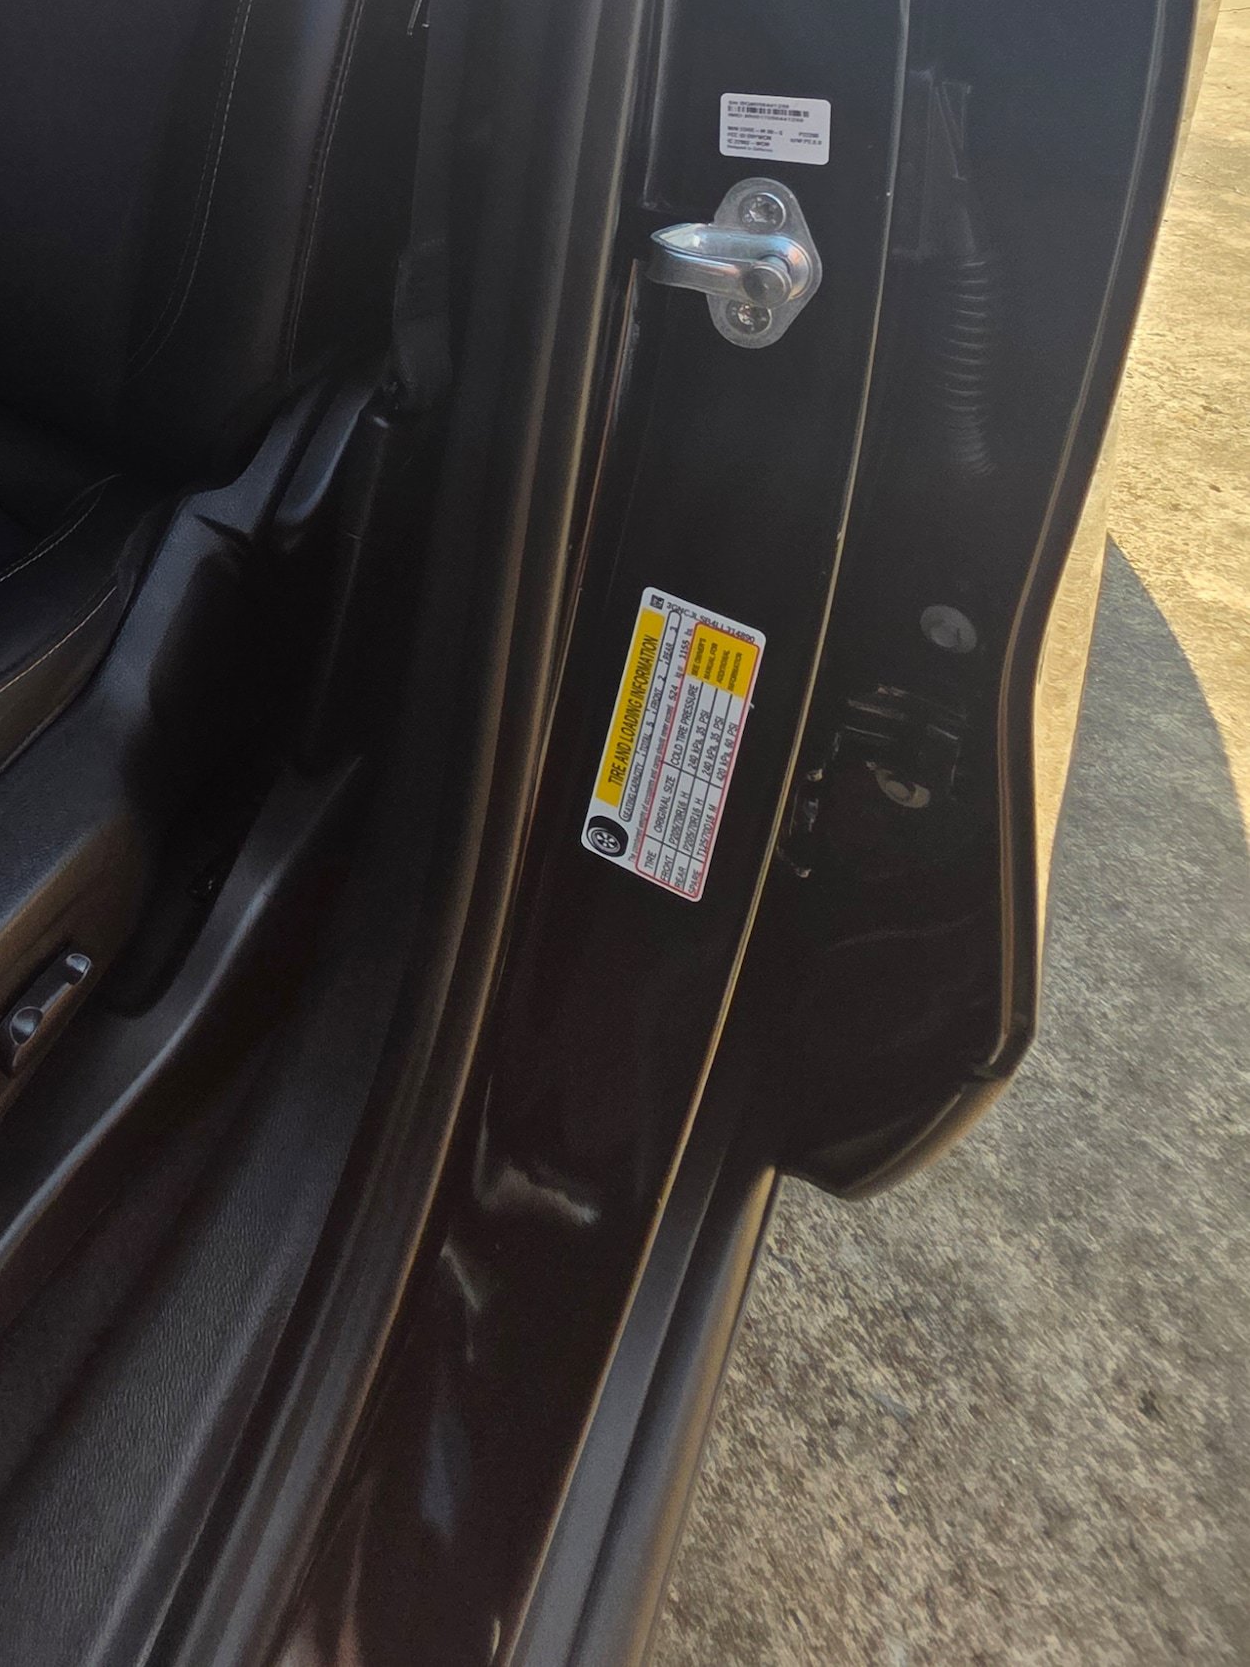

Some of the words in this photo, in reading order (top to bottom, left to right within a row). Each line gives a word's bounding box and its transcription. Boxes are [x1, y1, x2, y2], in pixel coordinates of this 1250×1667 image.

[694, 637, 706, 664] OWNER'S
[703, 655, 715, 680] MANUAL
[709, 642, 718, 655] FOR
[629, 633, 658, 700] INFORMATION
[667, 683, 678, 701] 524
[678, 638, 689, 659] 1155
[691, 664, 699, 676] SEE
[715, 649, 730, 684] ADDITIONAL
[726, 651, 742, 691] INFORMATION
[680, 683, 698, 725] PRESSURE
[618, 697, 642, 743] LOADING
[698, 709, 709, 724] PSI
[713, 715, 724, 730] PSI
[727, 721, 738, 736] PSI
[622, 791, 636, 820] SEATING
[629, 761, 643, 793] CAPACITY
[639, 732, 651, 753] TOTAL
[649, 686, 662, 710] FRONT
[662, 641, 673, 661] REAR
[675, 724, 688, 743] TIRE
[695, 725, 705, 736] 35
[709, 731, 720, 742] 35
[613, 741, 631, 765] AND
[670, 743, 683, 766] COLD
[724, 737, 734, 749] 60
[687, 754, 698, 769] 240
[701, 760, 712, 776] 240
[607, 762, 626, 788] TIRE
[663, 774, 675, 794] SIZE
[715, 766, 726, 782] 420
[653, 793, 670, 834] ORIGINAL
[668, 799, 687, 845] P205/70R16
[682, 805, 701, 852] P205/70R16
[644, 849, 656, 870] TIRE
[659, 854, 673, 882] FRONT
[674, 865, 686, 888] REAR
[687, 868, 701, 895] SPARE
